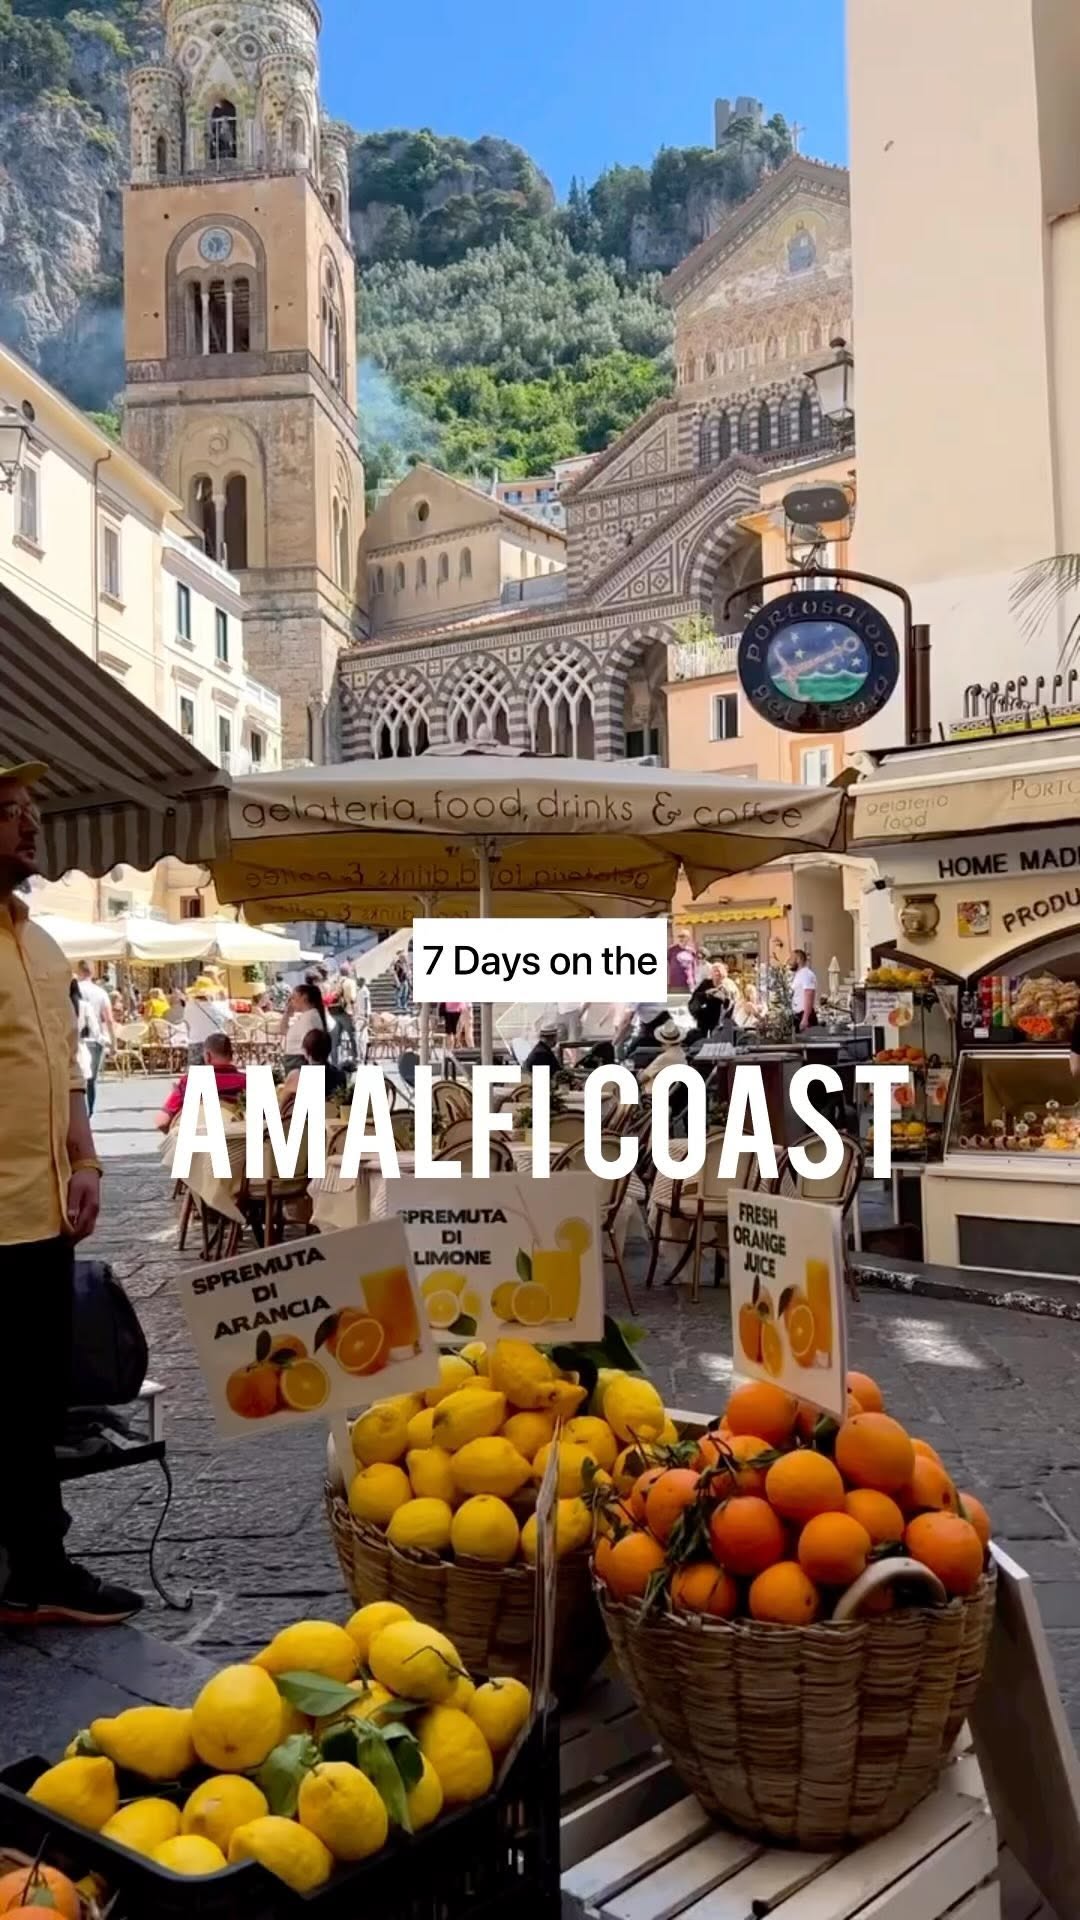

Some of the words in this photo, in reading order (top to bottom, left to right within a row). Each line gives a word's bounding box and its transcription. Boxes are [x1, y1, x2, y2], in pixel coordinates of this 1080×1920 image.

[433, 787, 528, 821] food,
[537, 789, 632, 821] drinks
[651, 791, 681, 826] &
[882, 810, 928, 831] food
[938, 852, 1008, 878] HOME
[1019, 846, 1080, 870] MAD
[739, 1203, 778, 1229] FRESH
[441, 1230, 462, 1245] DI
[733, 1226, 787, 1256] ORANGE
[414, 1250, 492, 1266] LIMONE
[744, 1252, 776, 1278] JUICE
[192, 1248, 327, 1296] SPREMUTA
[251, 1282, 278, 1304] DI
[214, 1295, 331, 1340] ARANCIA
